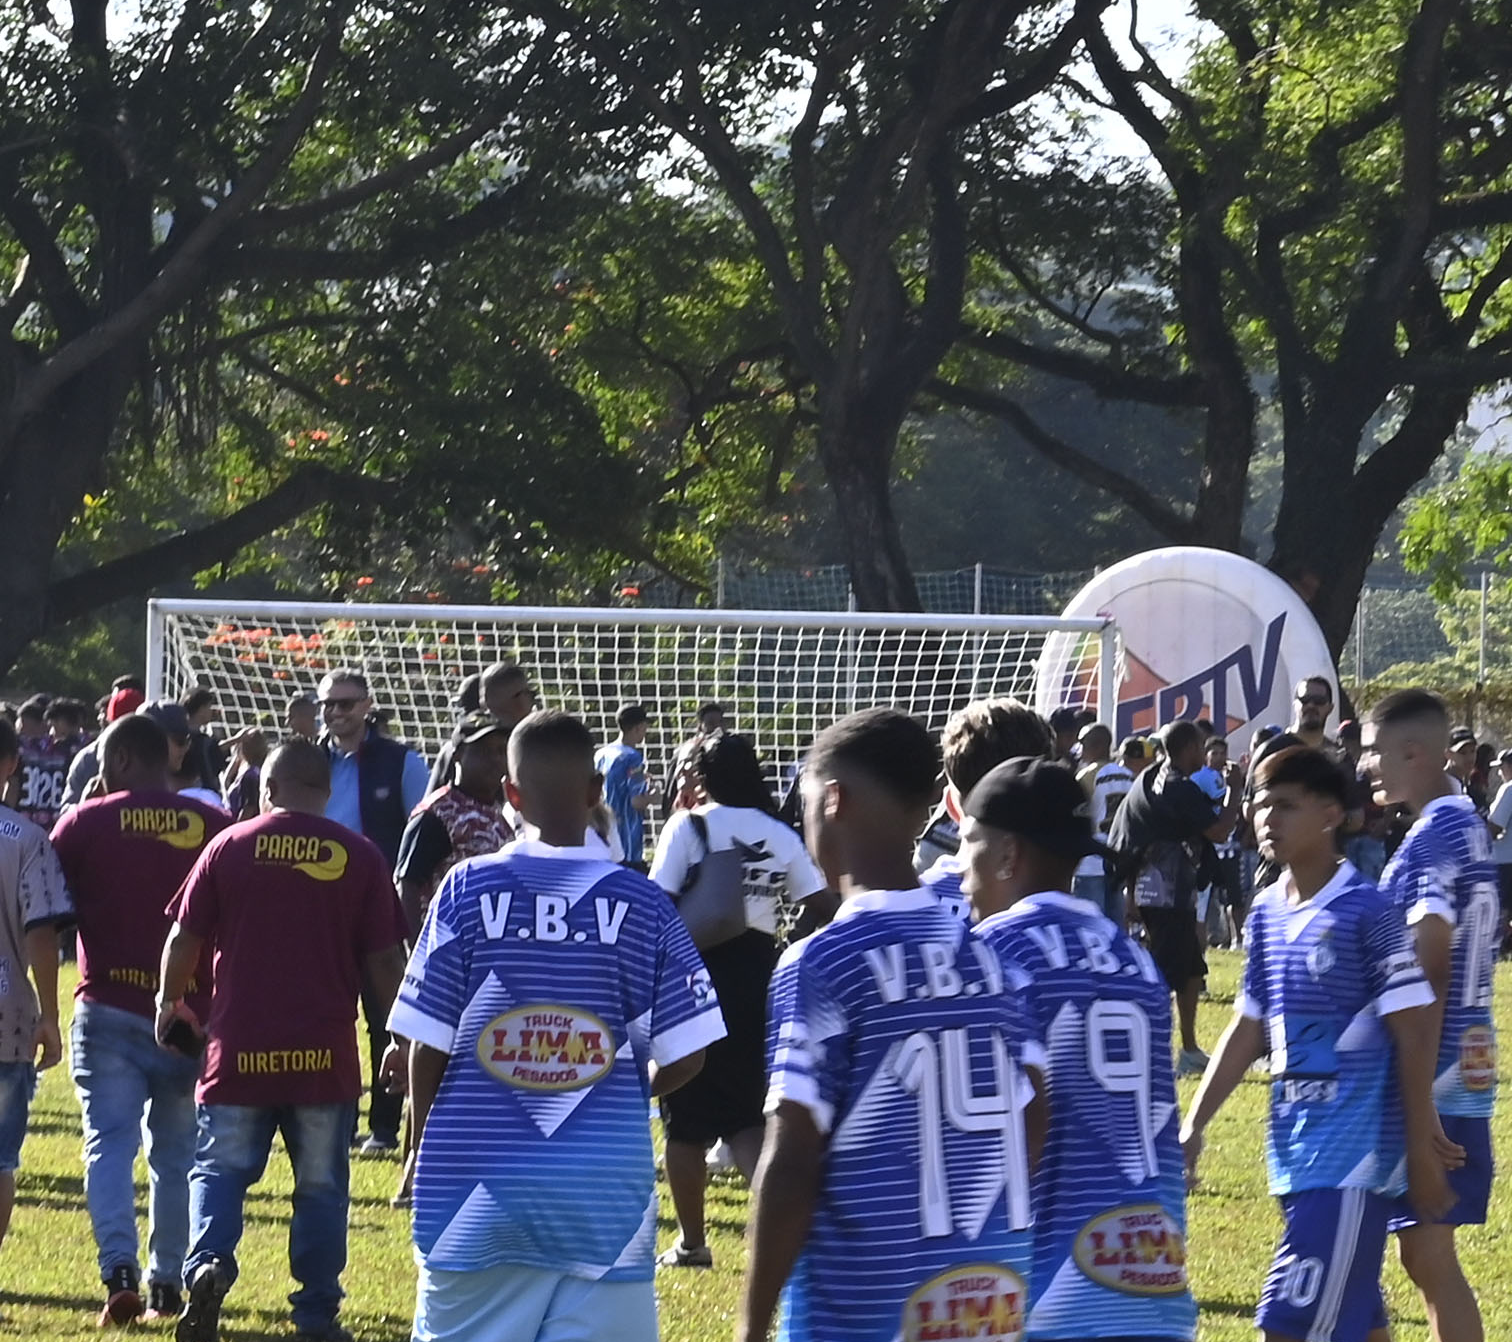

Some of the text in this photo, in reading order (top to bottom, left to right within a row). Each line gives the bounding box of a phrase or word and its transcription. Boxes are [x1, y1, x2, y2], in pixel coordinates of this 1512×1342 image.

[254, 835, 320, 863] PARÇA
[479, 890, 630, 945] V.B.V
[522, 1014, 574, 1030] TRUCK
[238, 1049, 332, 1074] DIRETORIA
[490, 1028, 607, 1066] LIMA
[511, 1065, 579, 1085] PESADOS
[1089, 999, 1160, 1179] 9
[892, 1029, 1032, 1239] 14
